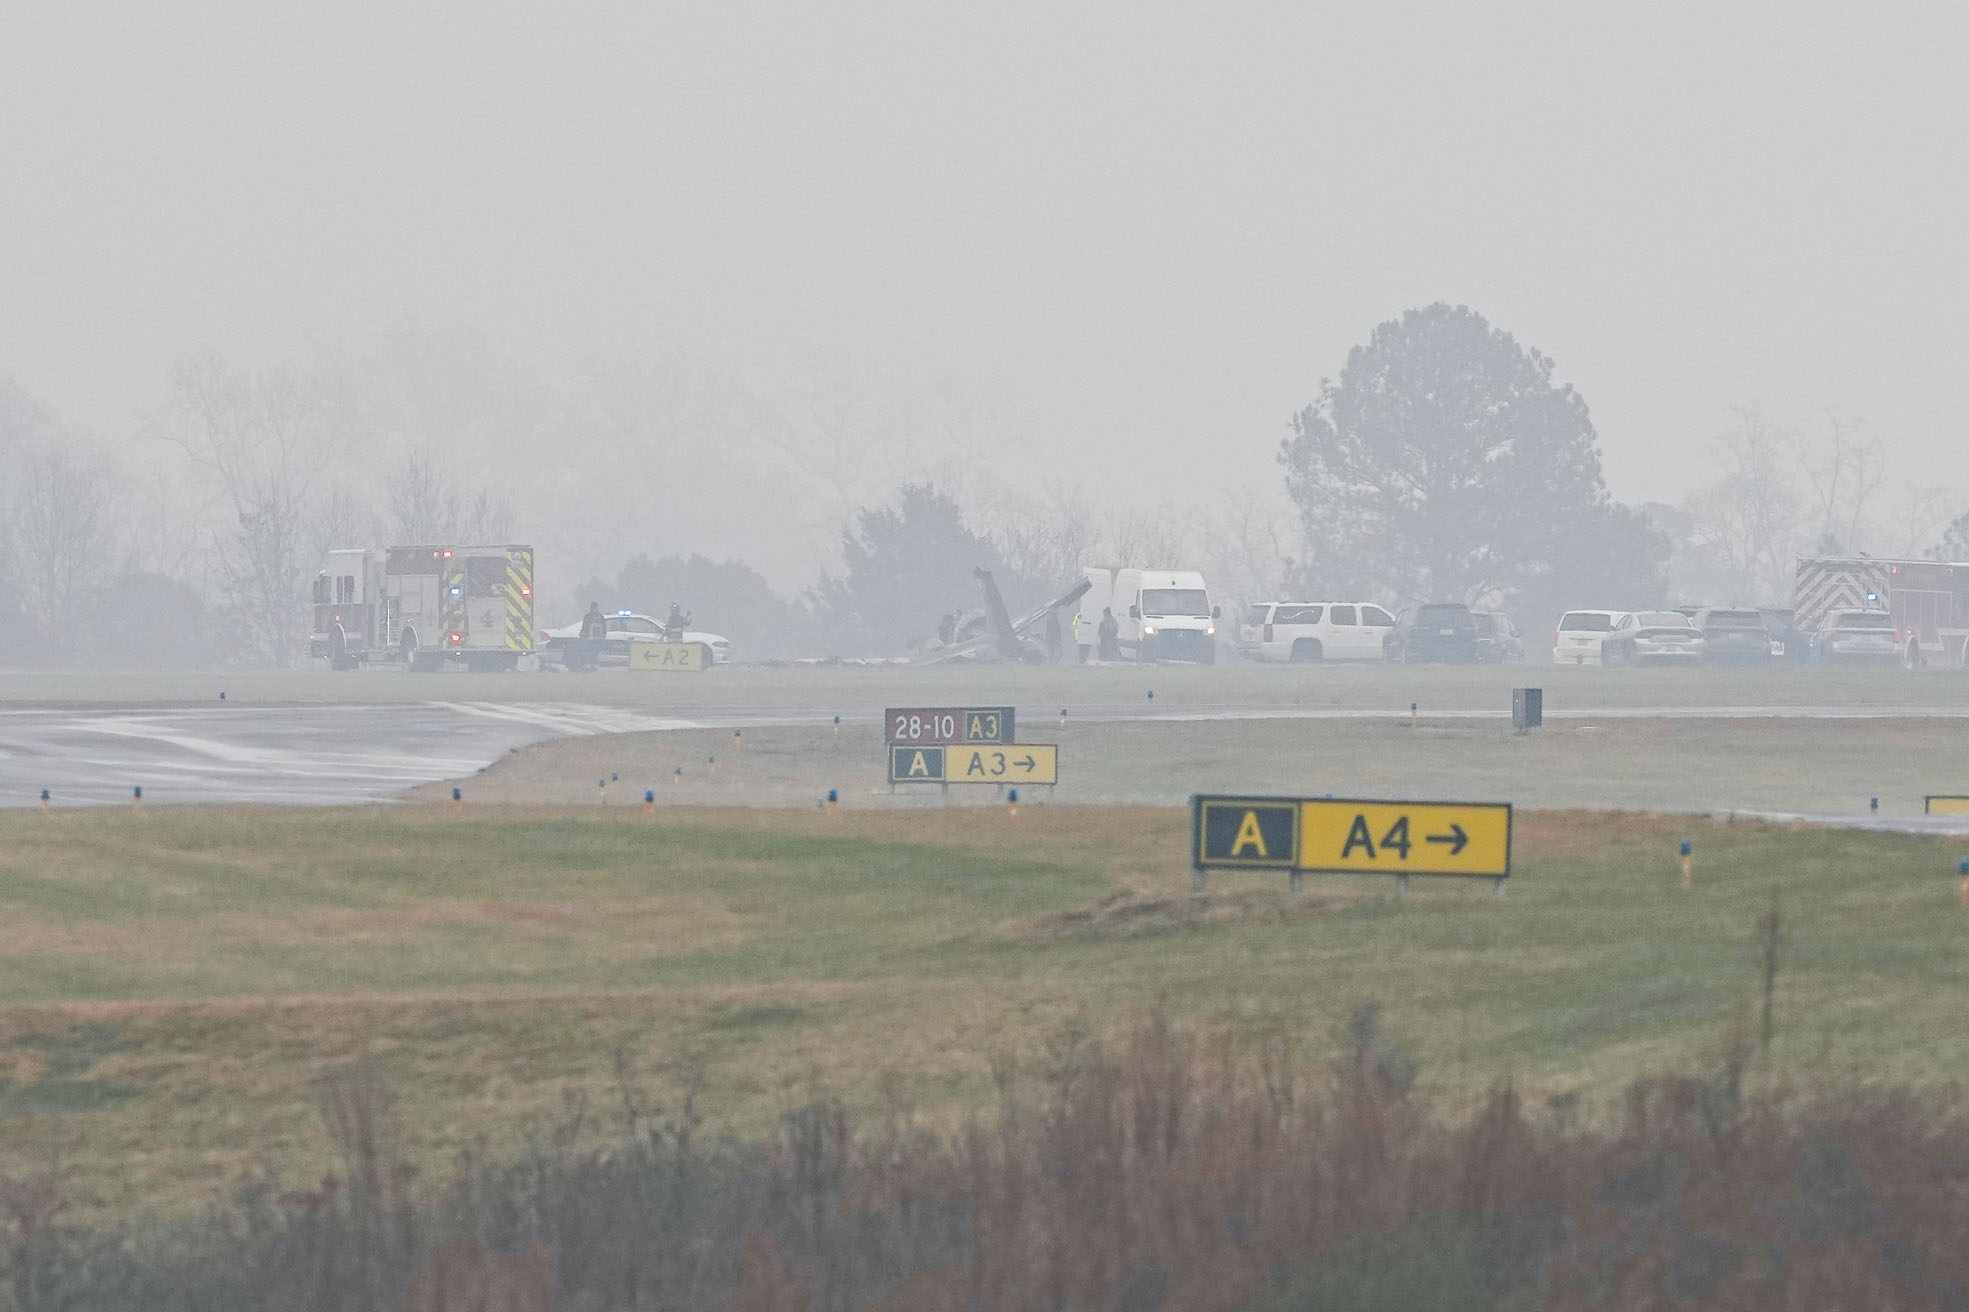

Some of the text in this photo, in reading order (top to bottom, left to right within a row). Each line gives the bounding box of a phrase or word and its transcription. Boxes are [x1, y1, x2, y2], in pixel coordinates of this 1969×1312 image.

[662, 648, 689, 665] A2
[895, 715, 998, 738] 28-10 A3
[909, 751, 1006, 775] A A3
[1231, 810, 1412, 859] A A4
